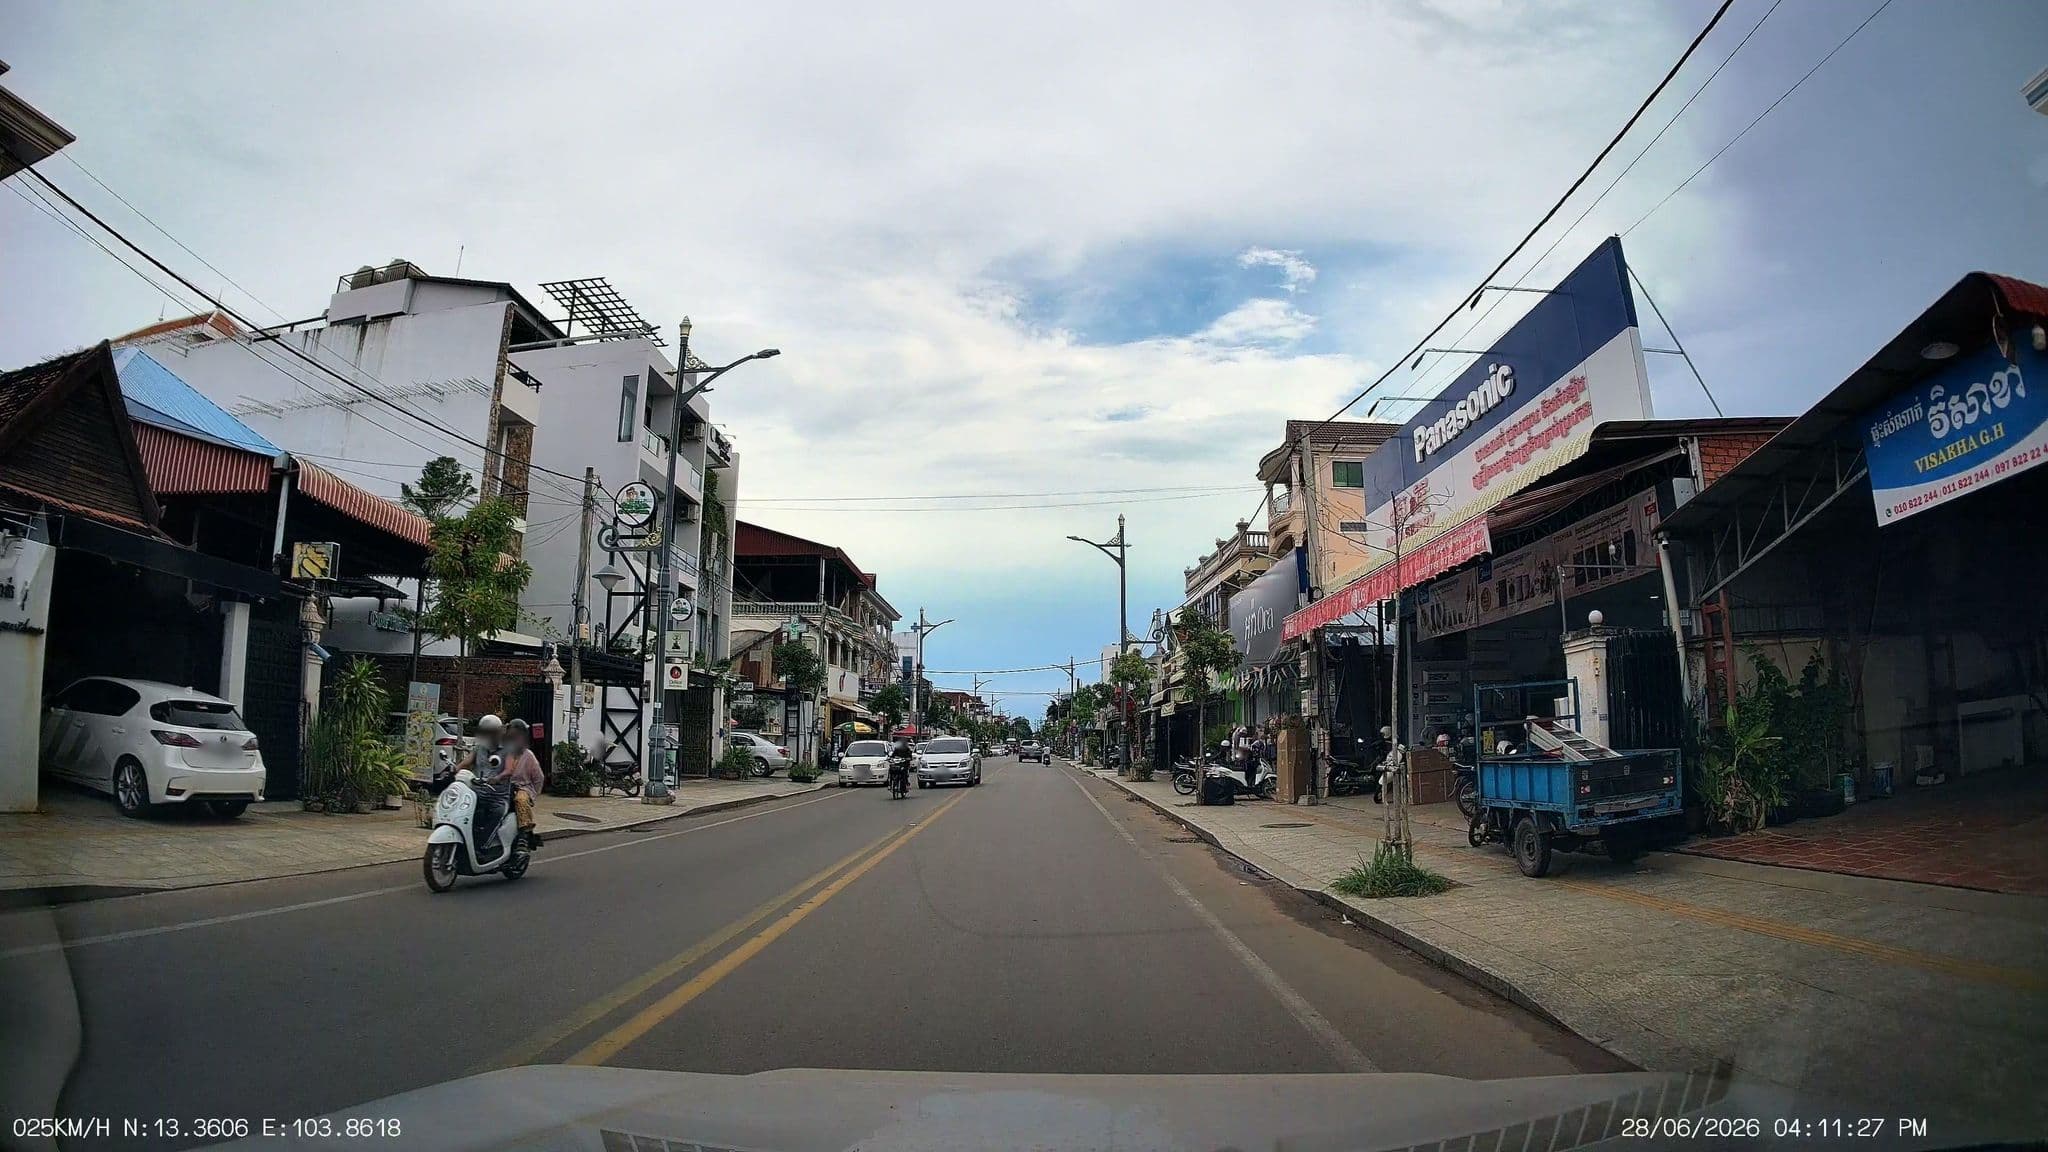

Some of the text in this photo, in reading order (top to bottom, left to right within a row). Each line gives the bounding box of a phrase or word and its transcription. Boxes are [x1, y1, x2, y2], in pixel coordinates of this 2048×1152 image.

[1413, 363, 1514, 463] Panasonic
[1893, 502, 1907, 515] 010
[1908, 496, 1923, 509] 822
[1923, 490, 1938, 504] 244
[1942, 483, 1956, 496] 011
[1958, 476, 1974, 489] 822
[1974, 468, 1990, 483] 244
[1994, 459, 2010, 474] 097
[2012, 452, 2029, 467] 822
[2030, 447, 2042, 461] 22
[1914, 422, 2006, 473] VISAKHA G.H
